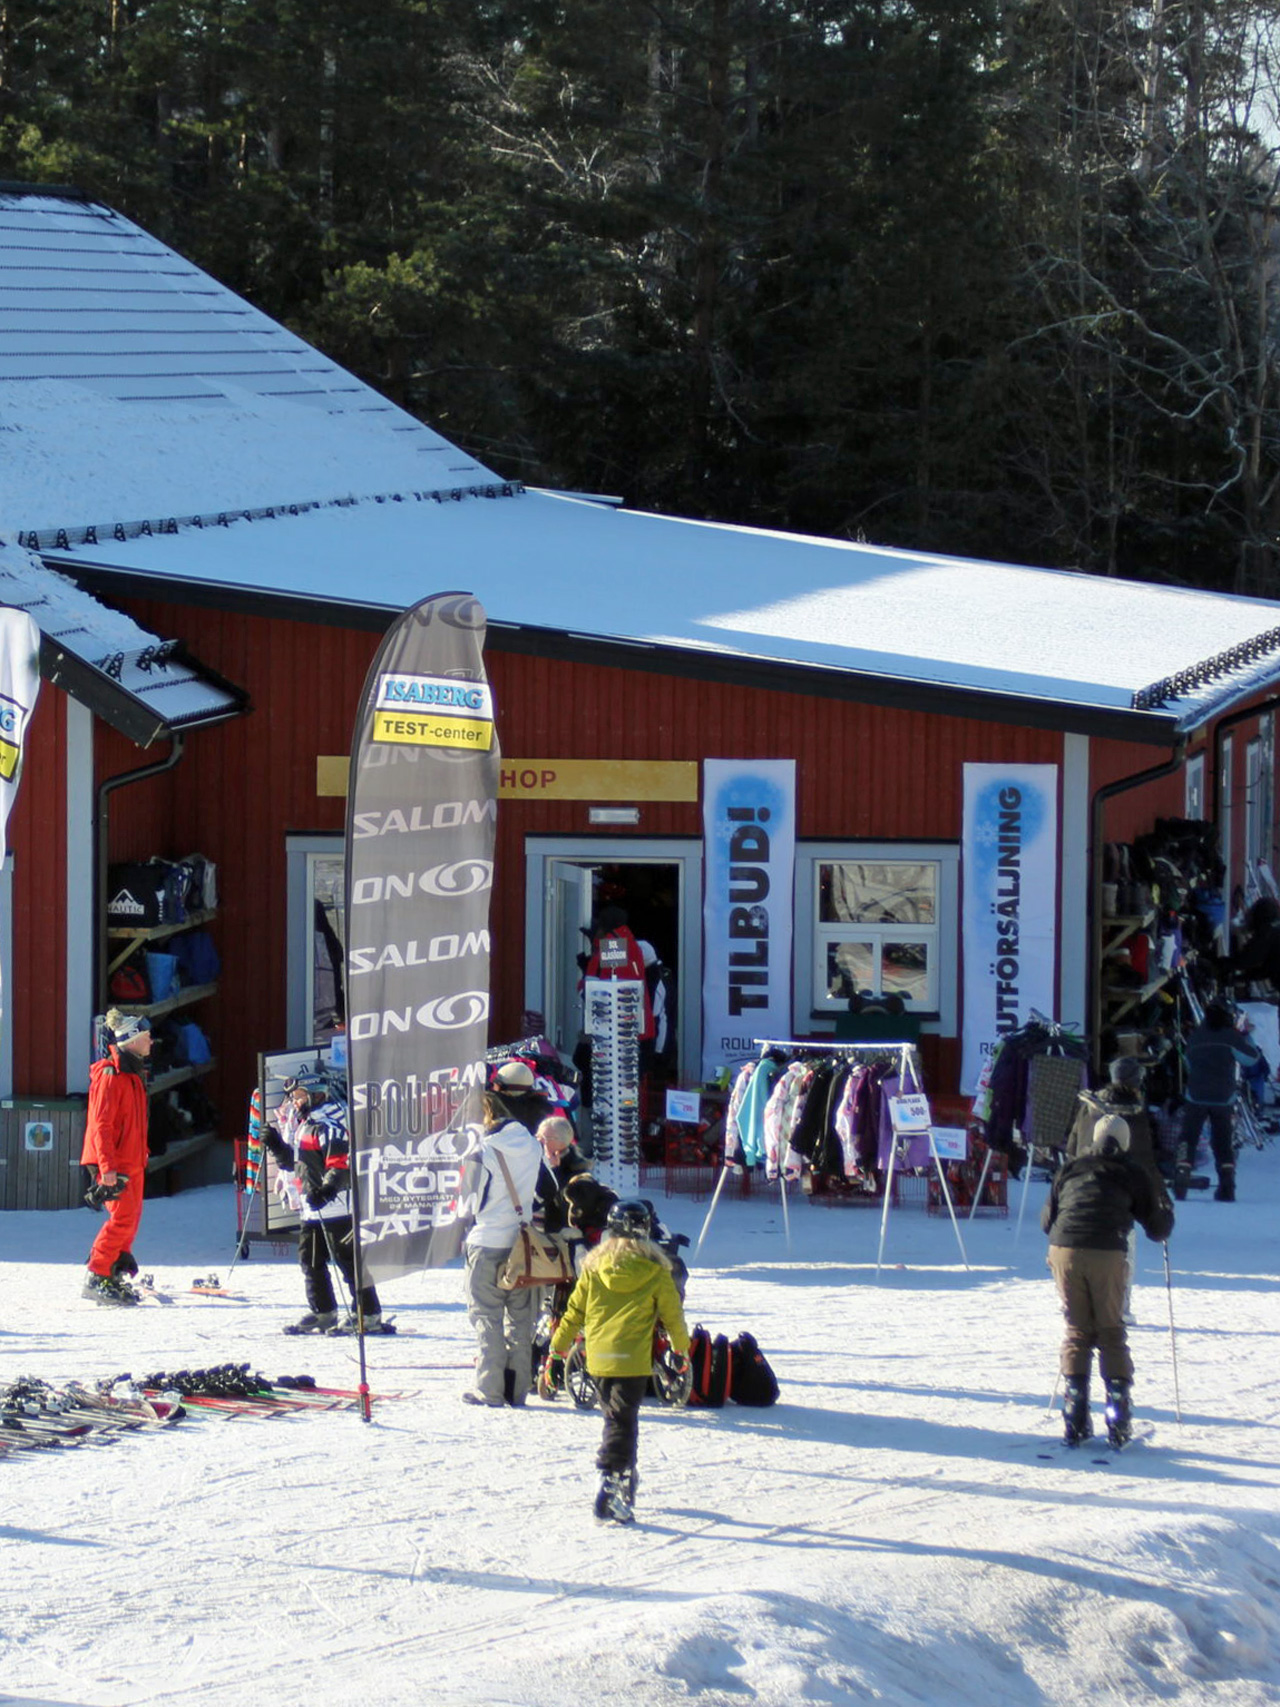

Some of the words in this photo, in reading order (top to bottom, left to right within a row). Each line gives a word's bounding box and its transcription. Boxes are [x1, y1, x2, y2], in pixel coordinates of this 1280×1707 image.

[384, 680, 483, 709] ISABERG
[382, 720, 482, 741] TEST-center
[499, 769, 557, 789] HOP
[352, 872, 415, 904] ON
[727, 806, 770, 1017] TILBUD!
[990, 786, 1021, 1034] UTFÖRSÄLJNING
[350, 1006, 412, 1041] ON
